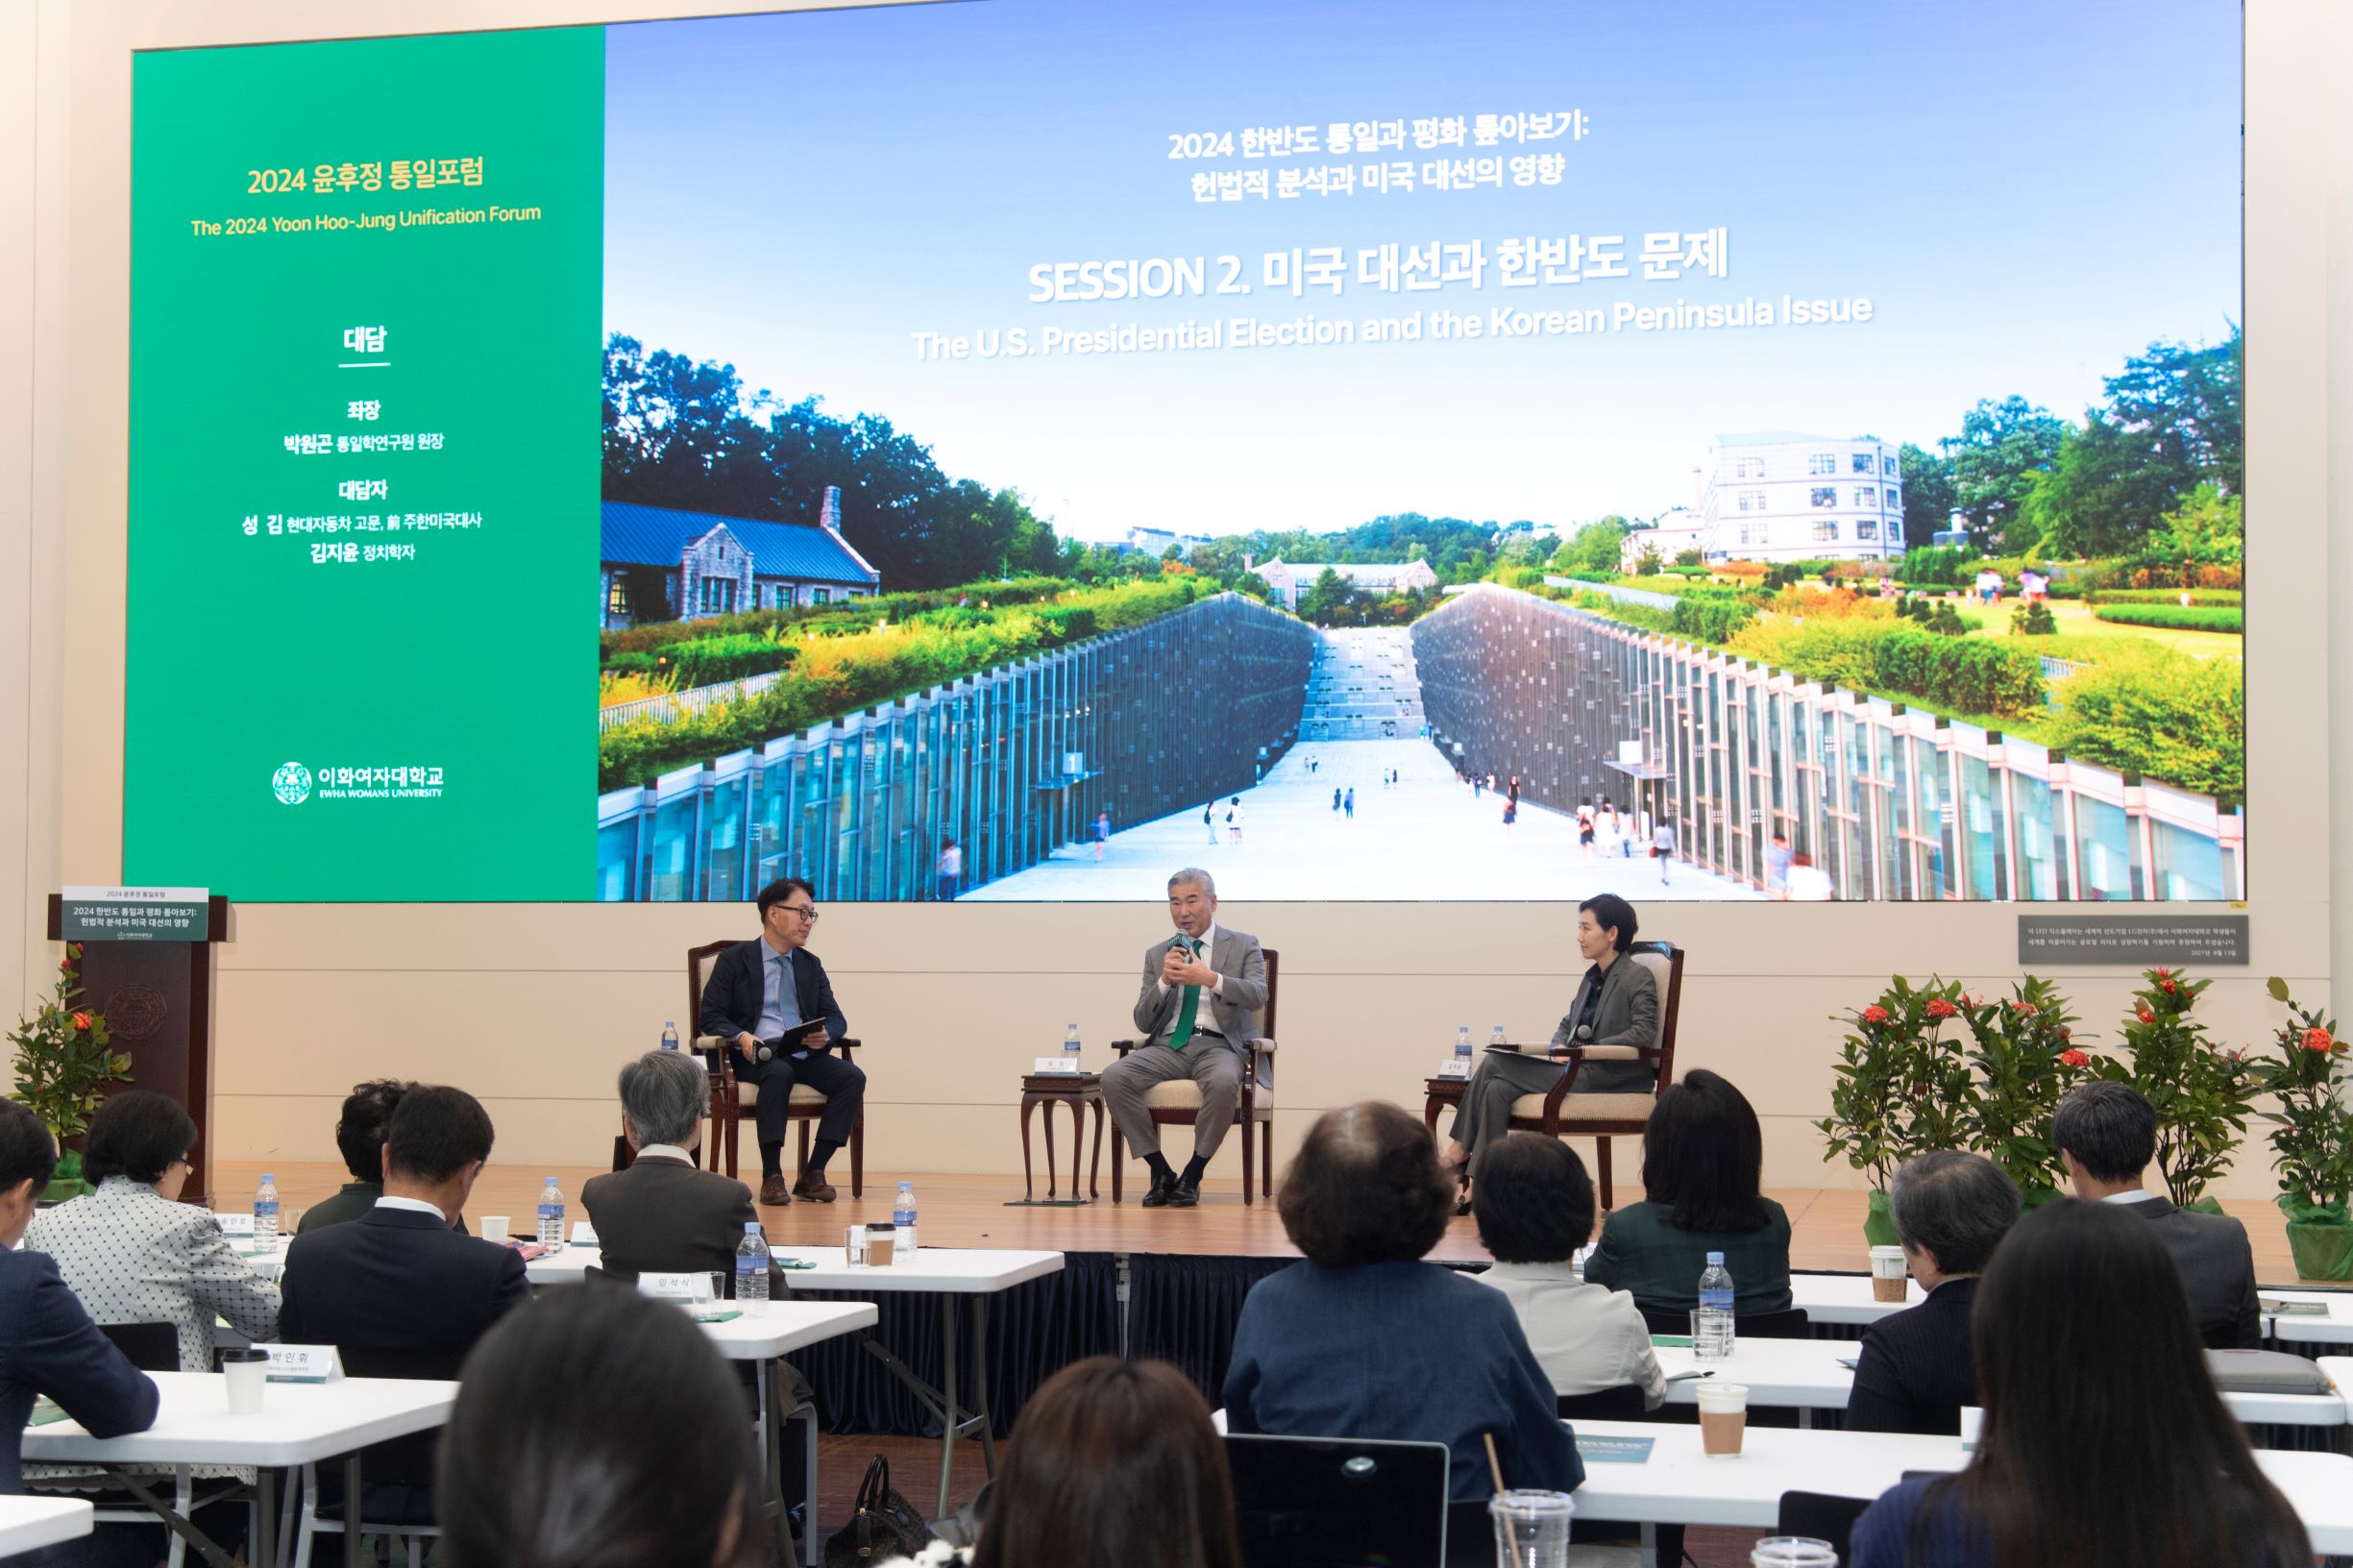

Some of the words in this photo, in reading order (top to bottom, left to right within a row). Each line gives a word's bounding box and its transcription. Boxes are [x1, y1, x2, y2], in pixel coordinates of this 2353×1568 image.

[1168, 132, 1235, 159] 2024
[1240, 126, 1320, 158] 한반도
[1326, 119, 1407, 154] 통일과
[1412, 115, 1467, 149] 평화
[1473, 109, 1589, 145] 톺아보기:
[248, 168, 306, 193] 2024
[312, 161, 381, 193] 윤후정
[389, 157, 482, 190] 통일포럼
[1191, 169, 1268, 202] 헌법적
[1276, 164, 1356, 198] 분석과
[1362, 161, 1416, 193] 미국
[1423, 156, 1502, 190] 대선의
[1509, 153, 1565, 186] 영향
[191, 220, 221, 235] The
[226, 217, 267, 234] 2024
[272, 217, 311, 232] Yoon
[315, 213, 396, 231] Hoo-Jung
[400, 208, 485, 227] Unification
[490, 206, 541, 222] Forum
[1029, 257, 1205, 303] SESSION
[1217, 255, 1251, 294] 2.
[1264, 247, 1347, 296] 미국
[1360, 240, 1485, 291] 대선과
[1498, 236, 1628, 284] 한반도
[1639, 228, 1728, 280] 문제
[913, 332, 968, 358] The
[978, 329, 1034, 355] U.S.
[1043, 321, 1220, 354] Presidential
[1231, 315, 1353, 346] Election
[1363, 312, 1420, 340] and
[1432, 312, 1481, 337] the
[1492, 308, 1604, 334] Korean
[1615, 298, 1772, 329] Peninsula
[1784, 297, 1871, 323] Issue
[344, 326, 387, 353] 대담
[348, 400, 380, 421] 좌장
[284, 434, 332, 454] 박원곤
[337, 434, 414, 453] 통일학연구원
[418, 433, 444, 450] 원장
[339, 479, 388, 501] 대담자
[242, 515, 257, 535] 성
[267, 514, 282, 534] 김
[287, 516, 351, 533] 현대자동차
[404, 512, 482, 529] 주한미국대사
[311, 542, 359, 563] 김지윤
[363, 545, 415, 561] 정치학자
[319, 767, 443, 788] 이화여자대학교
[319, 789, 347, 798] EWHA
[347, 789, 390, 798] WOMANS
[392, 789, 442, 798] UNIVERSITY
[73, 907, 94, 916] 2024
[95, 907, 120, 916] 한반도
[121, 908, 144, 917] 통일과
[106, 918, 130, 927] 분석과
[131, 918, 147, 927] 미국
[148, 919, 172, 927] 대선의
[173, 919, 189, 927] 영향
